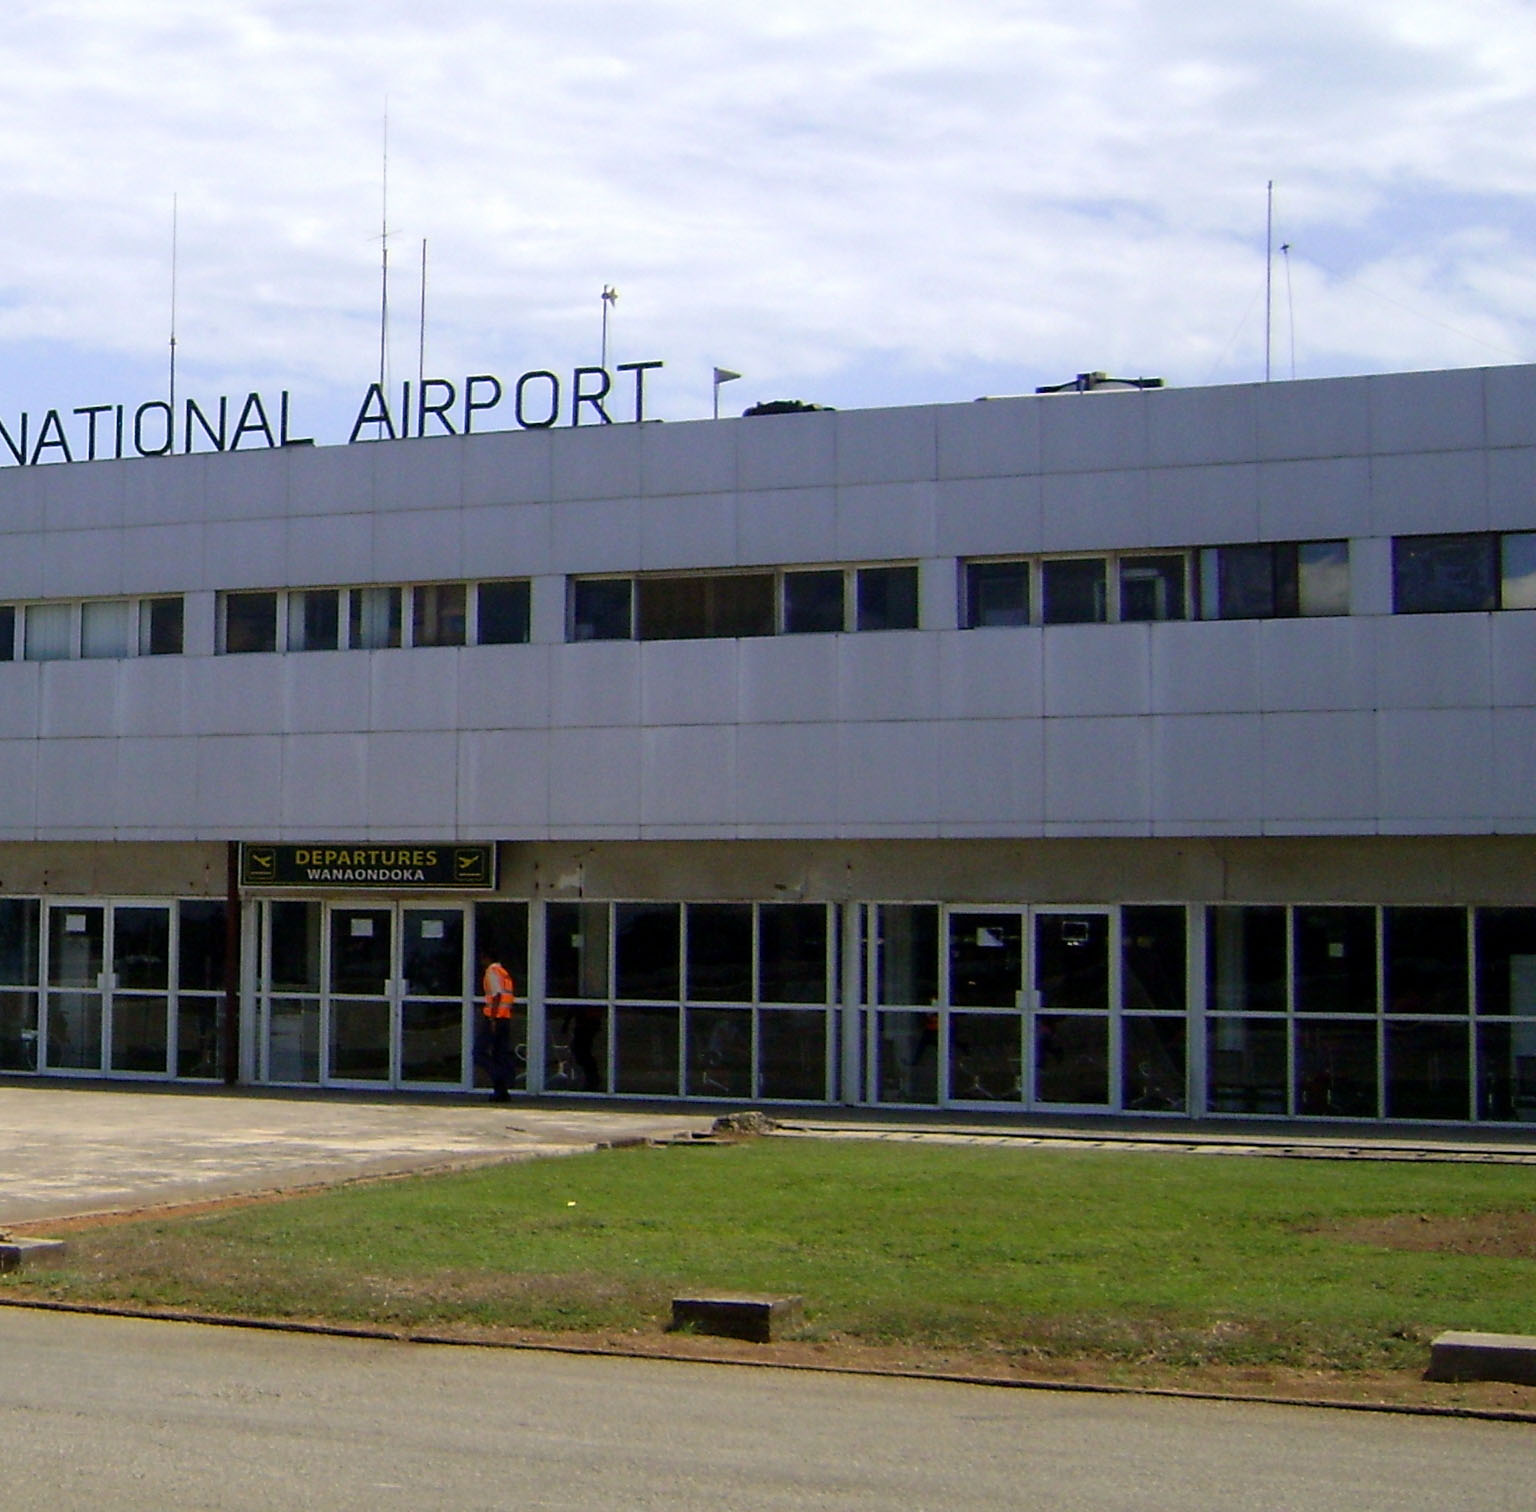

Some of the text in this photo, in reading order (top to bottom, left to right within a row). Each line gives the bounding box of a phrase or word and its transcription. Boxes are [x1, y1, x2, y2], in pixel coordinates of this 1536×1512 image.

[349, 361, 664, 444] AIRPORT
[294, 849, 438, 866] DEPARTURES
[307, 868, 425, 881] WANAONDOKA
